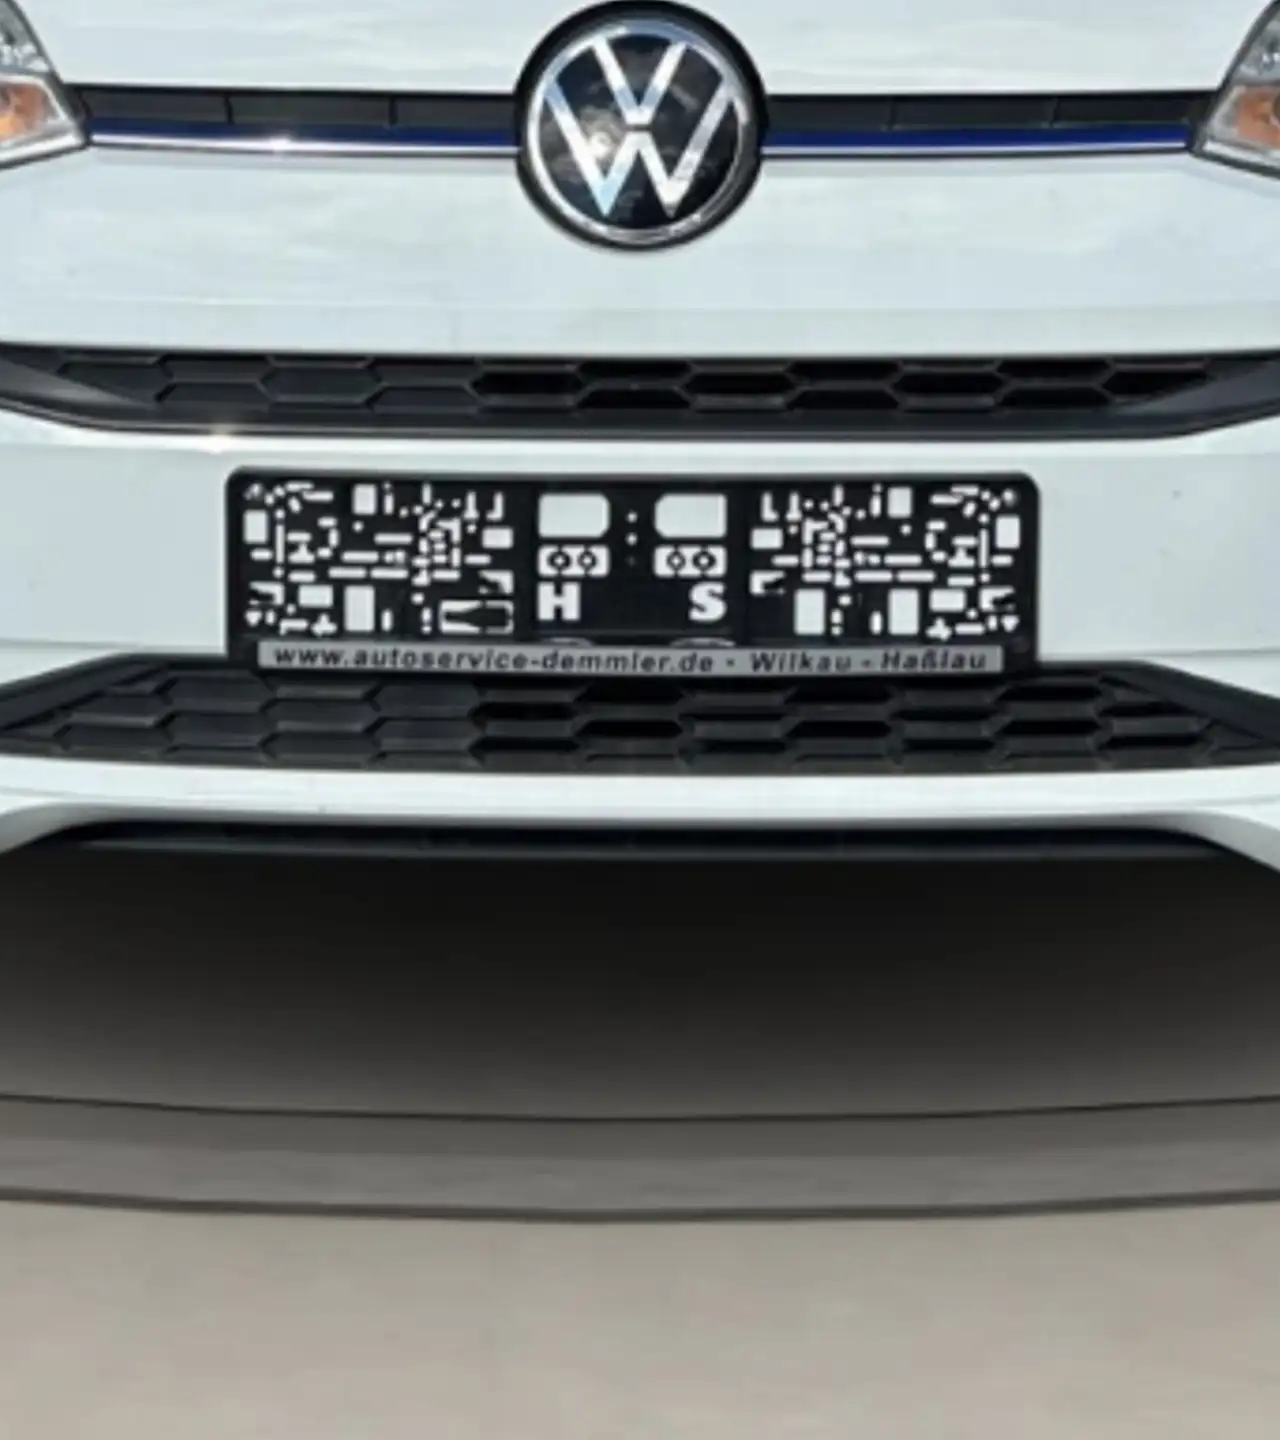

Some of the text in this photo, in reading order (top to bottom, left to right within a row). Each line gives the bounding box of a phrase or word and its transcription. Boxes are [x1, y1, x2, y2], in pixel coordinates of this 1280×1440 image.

[539, 32, 737, 223] VW
[538, 581, 727, 622] H S
[274, 647, 715, 672] www.autoservice-demmler.de
[749, 650, 852, 674] Wilkau
[879, 647, 987, 672] Haßlau
